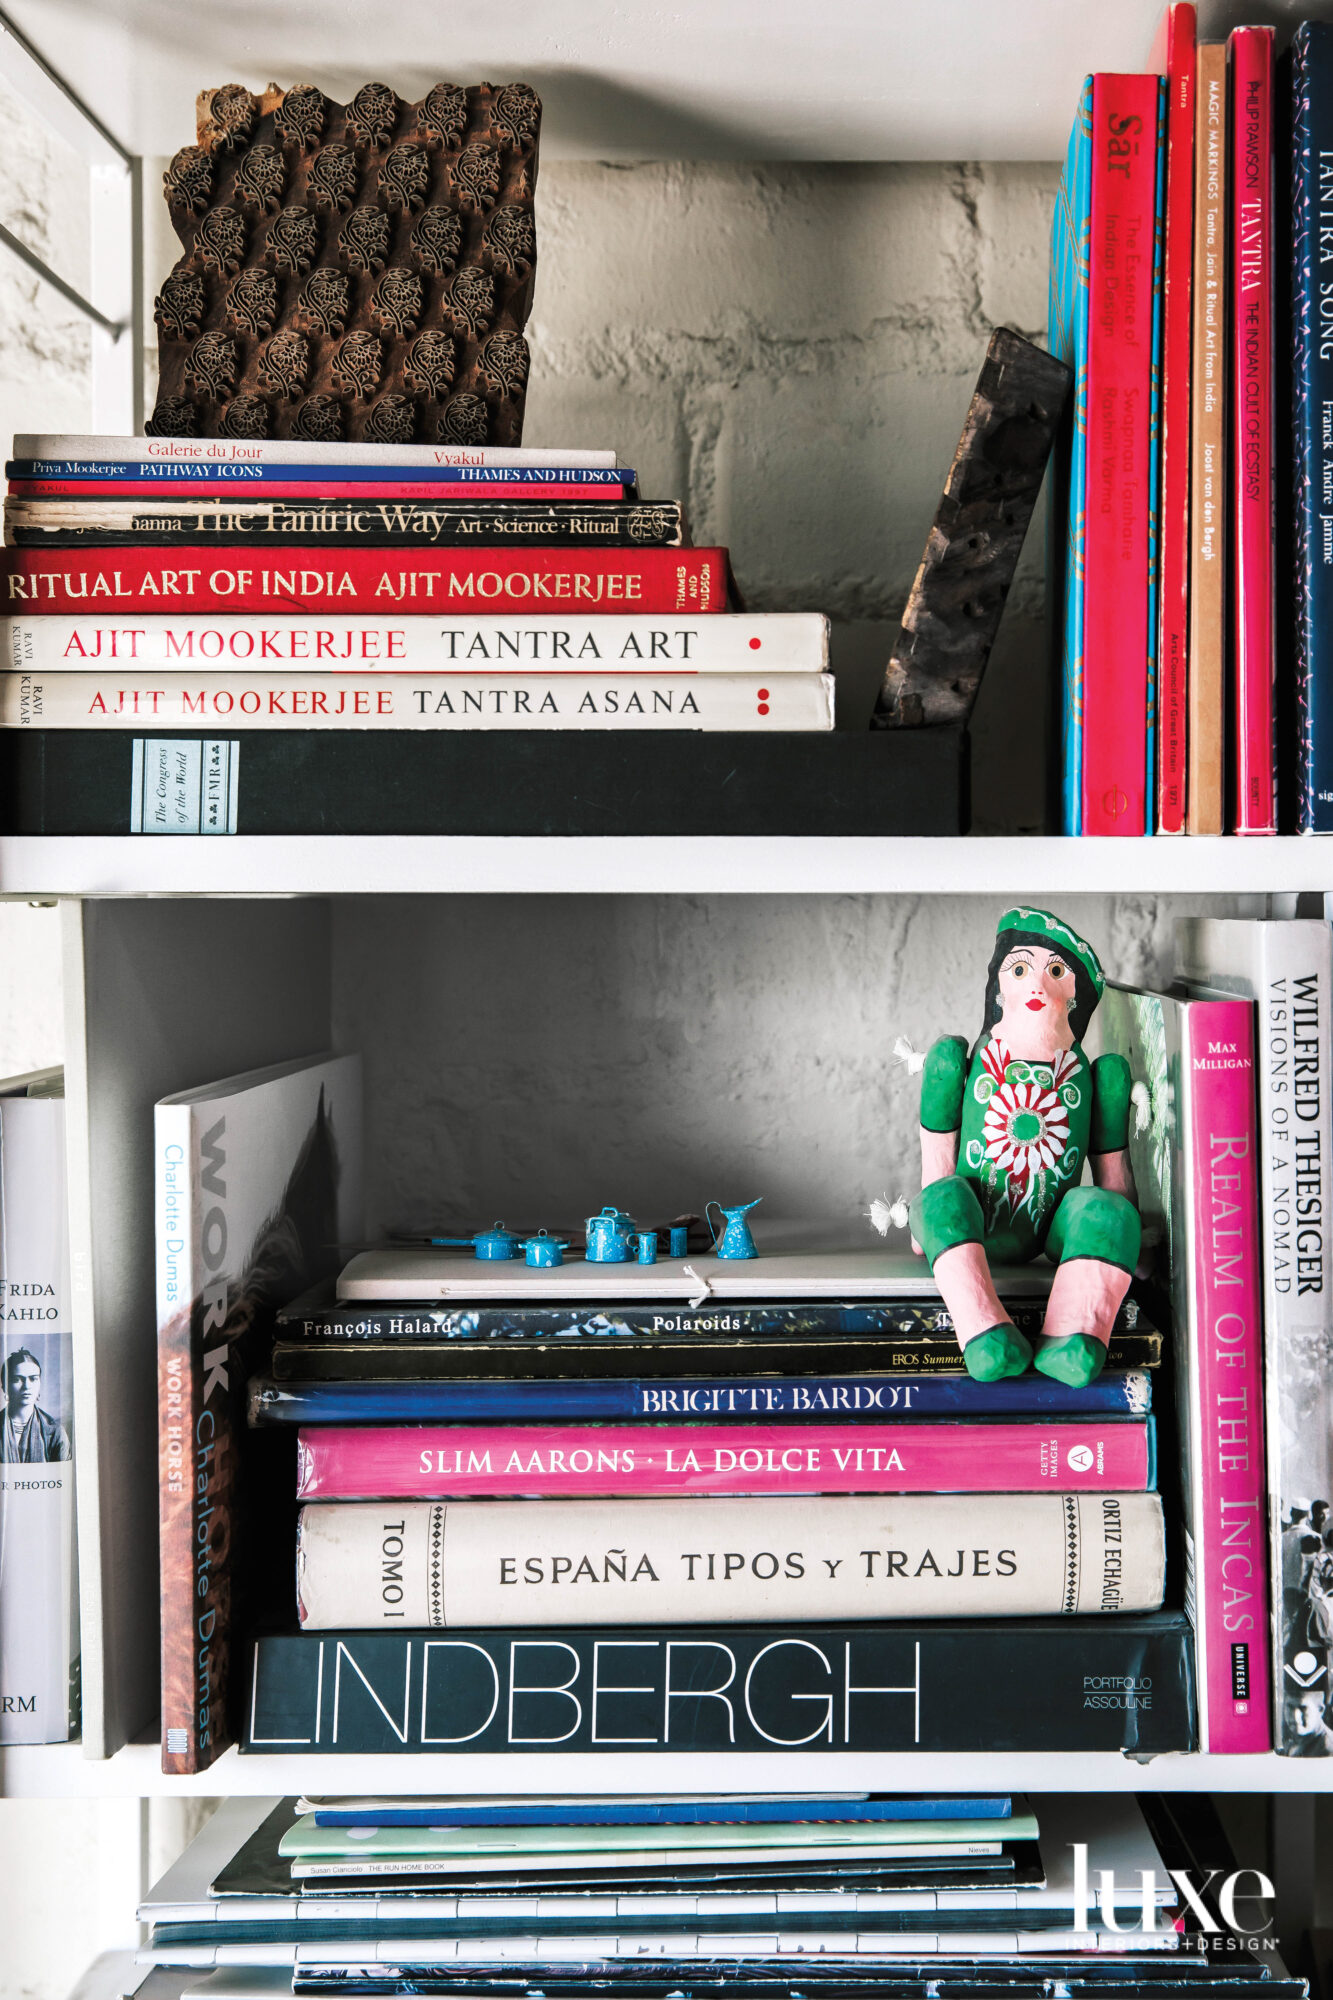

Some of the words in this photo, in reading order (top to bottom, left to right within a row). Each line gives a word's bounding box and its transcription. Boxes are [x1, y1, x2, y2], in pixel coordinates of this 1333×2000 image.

[1179, 75, 1190, 109] Tantra
[1208, 80, 1220, 125] MAGIC
[1246, 81, 1259, 122] PHILIP
[1108, 113, 1143, 179] Sār
[1246, 123, 1259, 188] RAWSON
[1207, 130, 1219, 200] MARKINGS
[1104, 214, 1119, 272] Indian
[1126, 215, 1141, 249] The
[1206, 207, 1219, 248] Tantra,
[1241, 198, 1262, 292] TANTRA
[1205, 251, 1218, 276] Jain
[1123, 253, 1140, 325] Essence
[1205, 280, 1218, 289] &
[1102, 277, 1119, 338] Design
[1205, 293, 1217, 325] Ritual
[1246, 302, 1259, 326] THE
[1123, 329, 1139, 348] of
[1204, 330, 1217, 348] Art
[1246, 328, 1259, 381] INDIAN
[1204, 353, 1216, 379] from
[1204, 385, 1216, 413] India
[1246, 382, 1260, 419] CULT
[1246, 420, 1260, 438] OF
[32, 460, 60, 476] Priya
[65, 462, 127, 477] Mookerjee
[140, 464, 212, 477] PATHWAY
[217, 465, 263, 478] ICONS
[148, 443, 202, 458] Galerie
[206, 443, 226, 458] du
[230, 444, 263, 461] Jour
[434, 451, 485, 466] Vyakul
[1204, 442, 1216, 472] Joost
[457, 468, 520, 481] THAMES
[523, 469, 556, 482] AND
[559, 470, 622, 483] HUDSON
[1203, 476, 1214, 498] van
[1245, 441, 1260, 502] ECSTASY
[133, 515, 183, 531] hanna
[258, 503, 371, 532] Tantric
[376, 504, 449, 541] Way
[455, 518, 482, 534] Art
[493, 518, 558, 535] Science
[569, 517, 620, 535] Ritual
[1203, 501, 1216, 523] den
[1200, 527, 1215, 561] Bergh
[8, 572, 132, 600] RITUAL
[138, 570, 201, 597] ART
[209, 570, 253, 596] OF
[261, 571, 358, 597] INDIA
[374, 571, 441, 601] AJIT
[448, 572, 642, 602] MOOKERJEE
[676, 566, 687, 610] THAMES
[690, 575, 699, 600] AND
[701, 563, 711, 611] HUDSON
[12, 625, 22, 667] KUMAR
[24, 632, 33, 660] RAVI
[63, 630, 146, 659] AJIT
[165, 630, 408, 659] MOOKERJEE
[441, 631, 603, 659] TANTRA
[618, 631, 699, 659] ART
[1169, 633, 1179, 653] Arts
[1169, 656, 1179, 695] Council
[20, 675, 30, 725] KUMAR
[33, 686, 42, 716] RAVI
[88, 691, 166, 714] AJIT
[182, 690, 394, 714] MOOKERJEE
[413, 690, 560, 714] TANTRA
[577, 690, 702, 714] ASANA
[1168, 697, 1178, 708] of
[1168, 709, 1178, 737] Great
[156, 747, 171, 798] Congress
[175, 752, 187, 787] World
[1168, 739, 1178, 773] Britain
[175, 789, 187, 808] the
[208, 768, 221, 801] FMR
[1169, 784, 1178, 806] 1971
[155, 800, 167, 824] The
[175, 807, 188, 824] of
[1270, 978, 1289, 1093] VISIONS
[1293, 973, 1321, 1123] WILFRED
[1271, 1107, 1290, 1141] OF
[1271, 1154, 1290, 1172] A
[164, 1143, 184, 1232] Charlotte
[1209, 1132, 1249, 1289] REALM
[1295, 1130, 1324, 1298] THESIGER
[1272, 1187, 1292, 1294] NOMAD
[166, 1239, 185, 1302] Dumas
[200, 1115, 230, 1406] WORK
[0, 1279, 56, 1296] FRIDA
[303, 1318, 382, 1336] François
[389, 1317, 453, 1335] Halard
[653, 1314, 741, 1332] Polaroids
[1214, 1312, 1247, 1369] OF
[892, 1353, 919, 1366] EROS
[165, 1357, 182, 1420] WORK
[642, 1386, 782, 1412] BRIGITTE
[792, 1386, 919, 1410] BARDOT
[1217, 1386, 1250, 1473] THE
[167, 1426, 183, 1493] HORSE
[419, 1449, 492, 1474] SLIM
[504, 1449, 635, 1473] AARONS
[664, 1448, 703, 1473] LA
[714, 1448, 820, 1472] DOLCE
[831, 1447, 906, 1472] VITA
[1041, 1441, 1049, 1476] GETTY
[1050, 1439, 1058, 1477] IMAGES
[1097, 1441, 1105, 1476] ABRAMS
[14, 1479, 63, 1490] PHOTOS
[196, 1410, 216, 1598] Charlotte
[1102, 1499, 1122, 1543] ORTIZ
[382, 1520, 405, 1605] TOMO
[499, 1548, 660, 1585] ESPAÑA
[681, 1551, 805, 1581] TIPOS
[859, 1547, 1018, 1578] TRAJES
[1101, 1547, 1124, 1612] ECHAGÜE
[1220, 1496, 1259, 1632] INCAS
[198, 1608, 217, 1750] Dumas
[1083, 1676, 1153, 1690] PORTFOLIO
[1235, 1645, 1246, 1697] UNIVERSE
[249, 1638, 921, 1745] LINDBERGH
[1083, 1696, 1153, 1710] ASSOULINE
[968, 1846, 990, 1854] Nieves
[310, 1866, 331, 1874] Susan
[332, 1865, 363, 1874] Cianciolo
[368, 1864, 383, 1872] THE
[384, 1863, 400, 1872] RUN
[401, 1863, 422, 1871] HOME
[424, 1862, 445, 1871] BOOK
